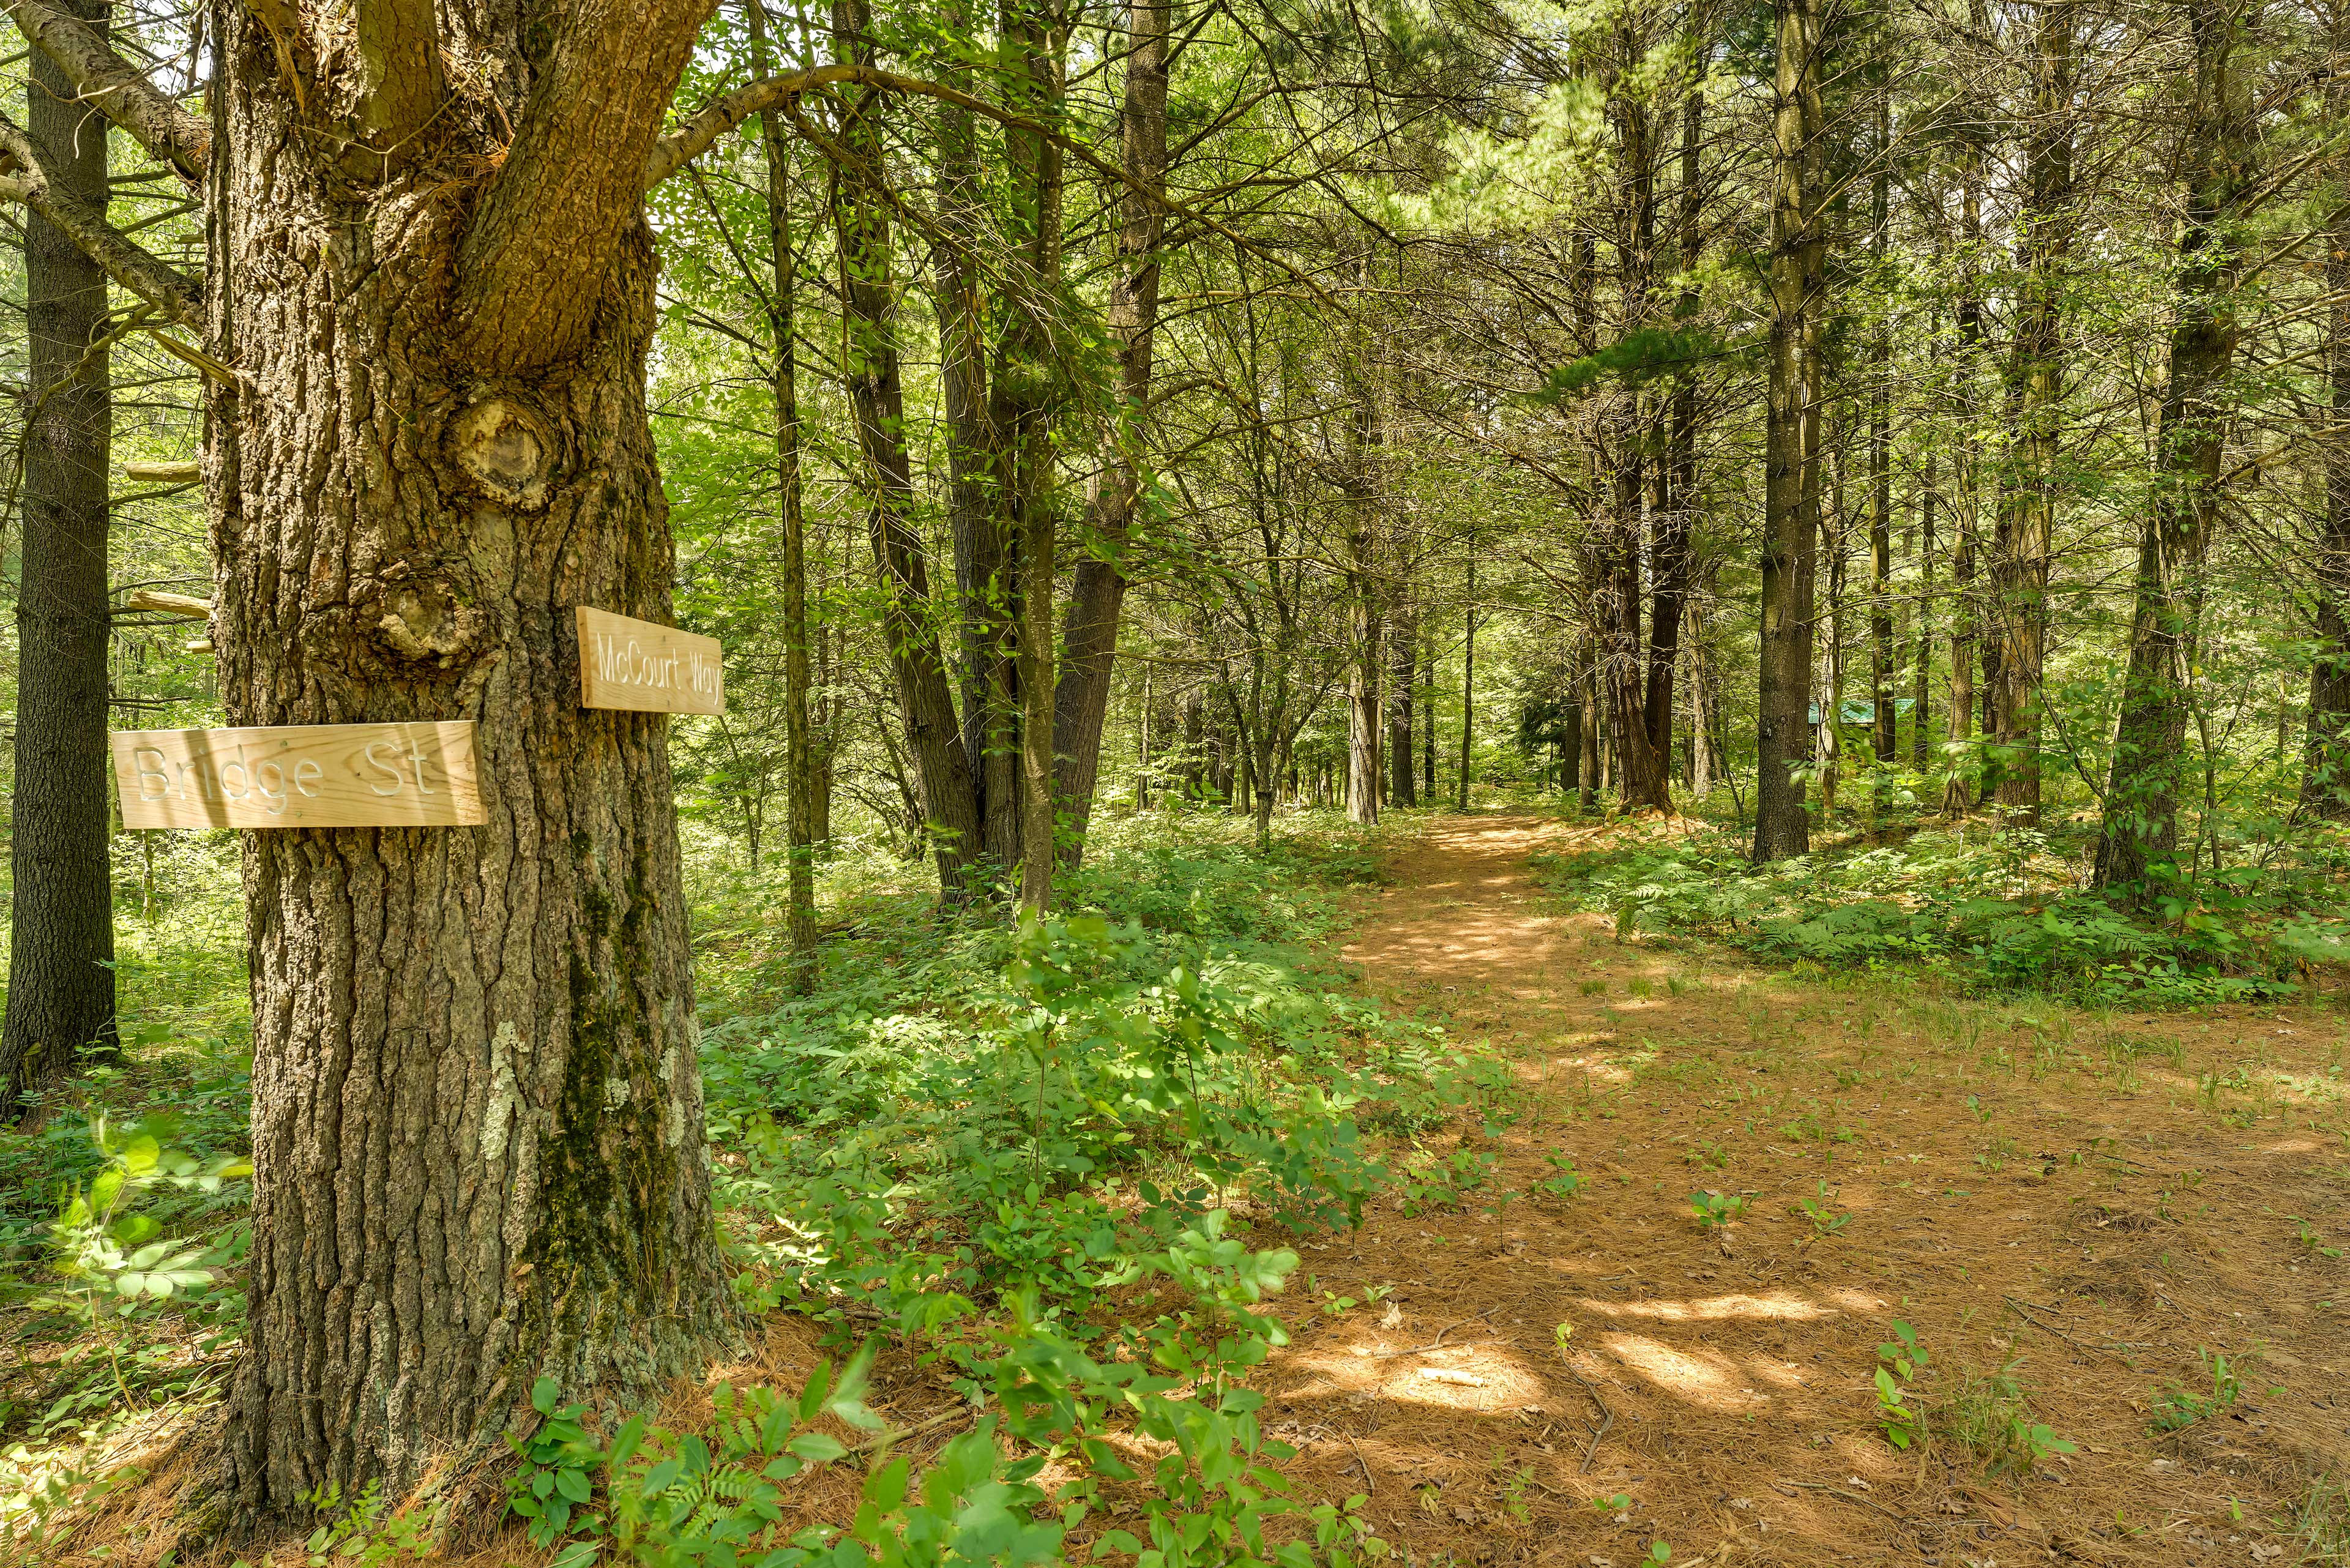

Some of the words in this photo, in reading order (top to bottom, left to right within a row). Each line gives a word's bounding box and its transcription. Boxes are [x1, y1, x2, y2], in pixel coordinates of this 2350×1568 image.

[597, 632, 681, 690] McCourt
[689, 651, 720, 706] Way
[133, 743, 324, 815] Bridge
[365, 738, 435, 795] St
